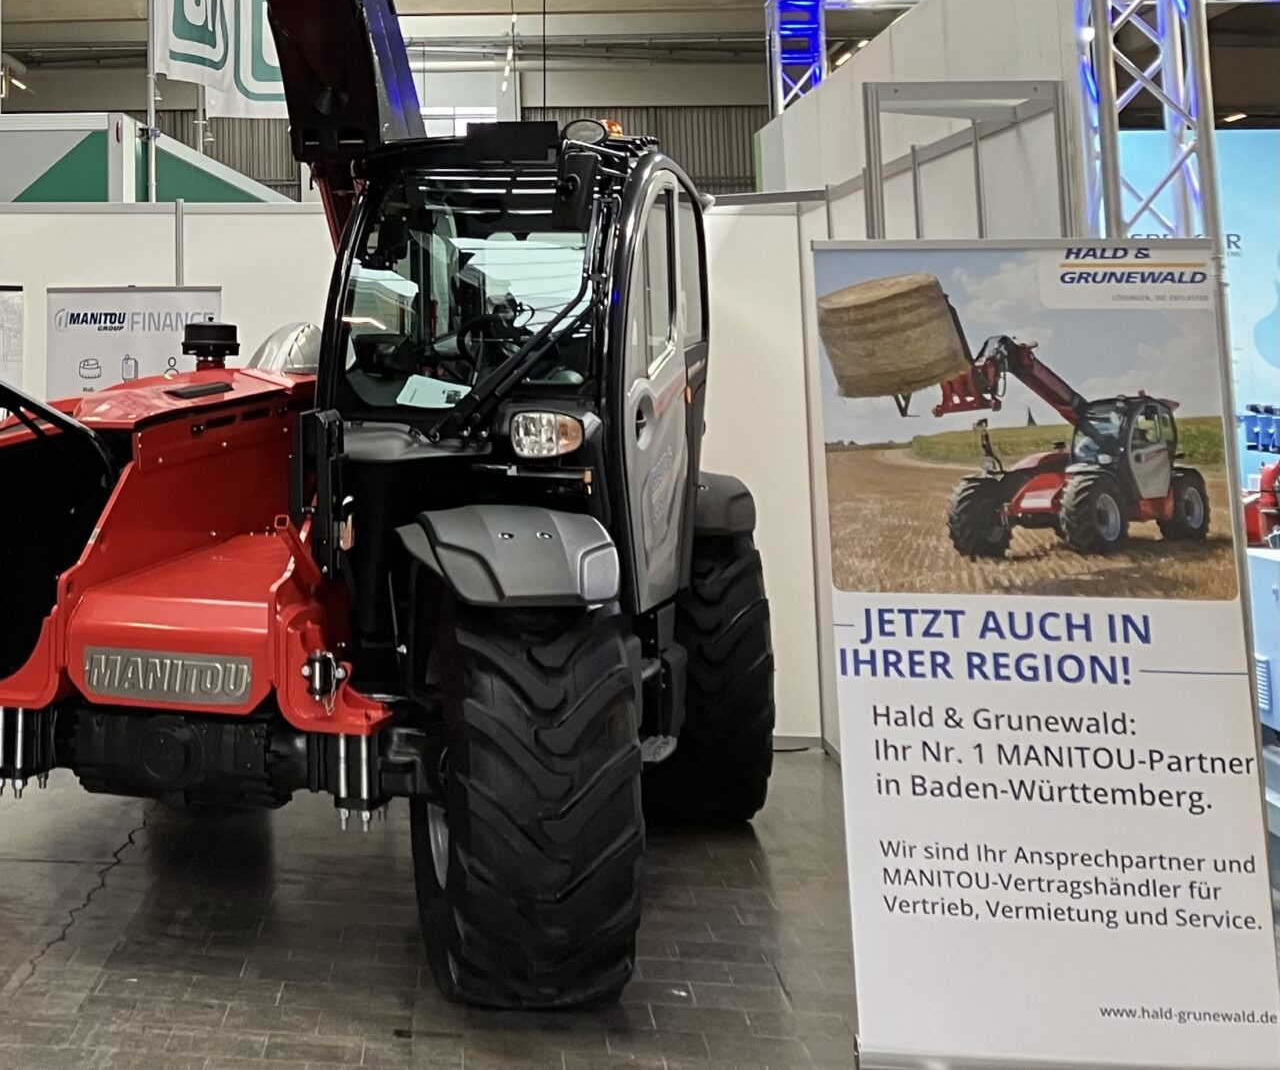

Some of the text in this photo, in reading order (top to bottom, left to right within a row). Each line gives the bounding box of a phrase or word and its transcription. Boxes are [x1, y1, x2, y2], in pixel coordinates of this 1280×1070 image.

[1065, 248, 1150, 260] HALD &
[1060, 271, 1207, 284] GRUNEWALD
[69, 312, 126, 325] MANITOU
[860, 608, 1150, 644] JETZT AUCH IN
[90, 655, 248, 696] MANITOU
[840, 648, 1131, 685] IHRER REGION!
[873, 705, 1136, 735] Hald & Grunewald:
[875, 738, 1255, 774] Ihr Nr. 1 MANITOU-Partner
[877, 773, 1213, 815] in Baden-Württemberg.
[880, 840, 1255, 873] Wir sind Ihr Ansprechpartner und
[883, 868, 1221, 900] MANITOU-Vertragshändler für
[884, 896, 1262, 929] Vertrieb, Vermietung und Service.
[1100, 1005, 1277, 1024] www.hald-grunewald.de
